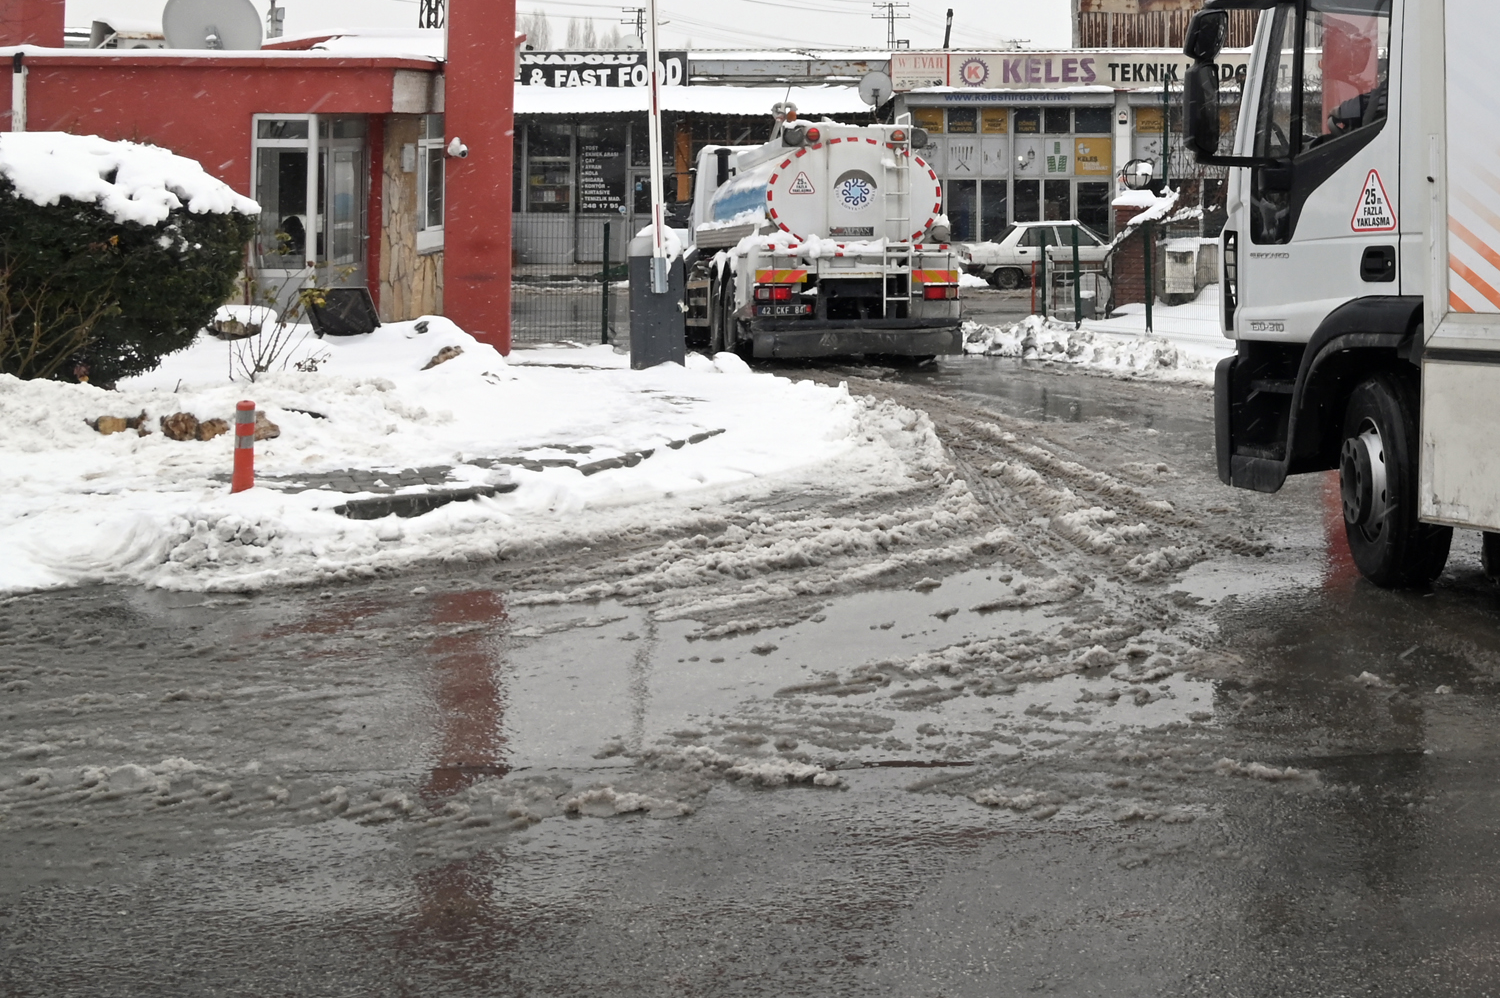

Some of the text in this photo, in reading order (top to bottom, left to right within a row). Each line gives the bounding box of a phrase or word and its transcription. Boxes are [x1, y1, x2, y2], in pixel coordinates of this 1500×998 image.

[967, 66, 980, 79] K
[1002, 57, 1096, 86] KELEŞ
[529, 68, 547, 87] &
[554, 69, 611, 87] FAST
[944, 93, 1071, 102] www.keleshirdavat.net
[1365, 188, 1376, 205] 25
[1363, 207, 1383, 216] FAZLA
[1357, 217, 1390, 227] YAKLAŞMA
[761, 306, 771, 315] 42
[776, 306, 790, 314] CKF
